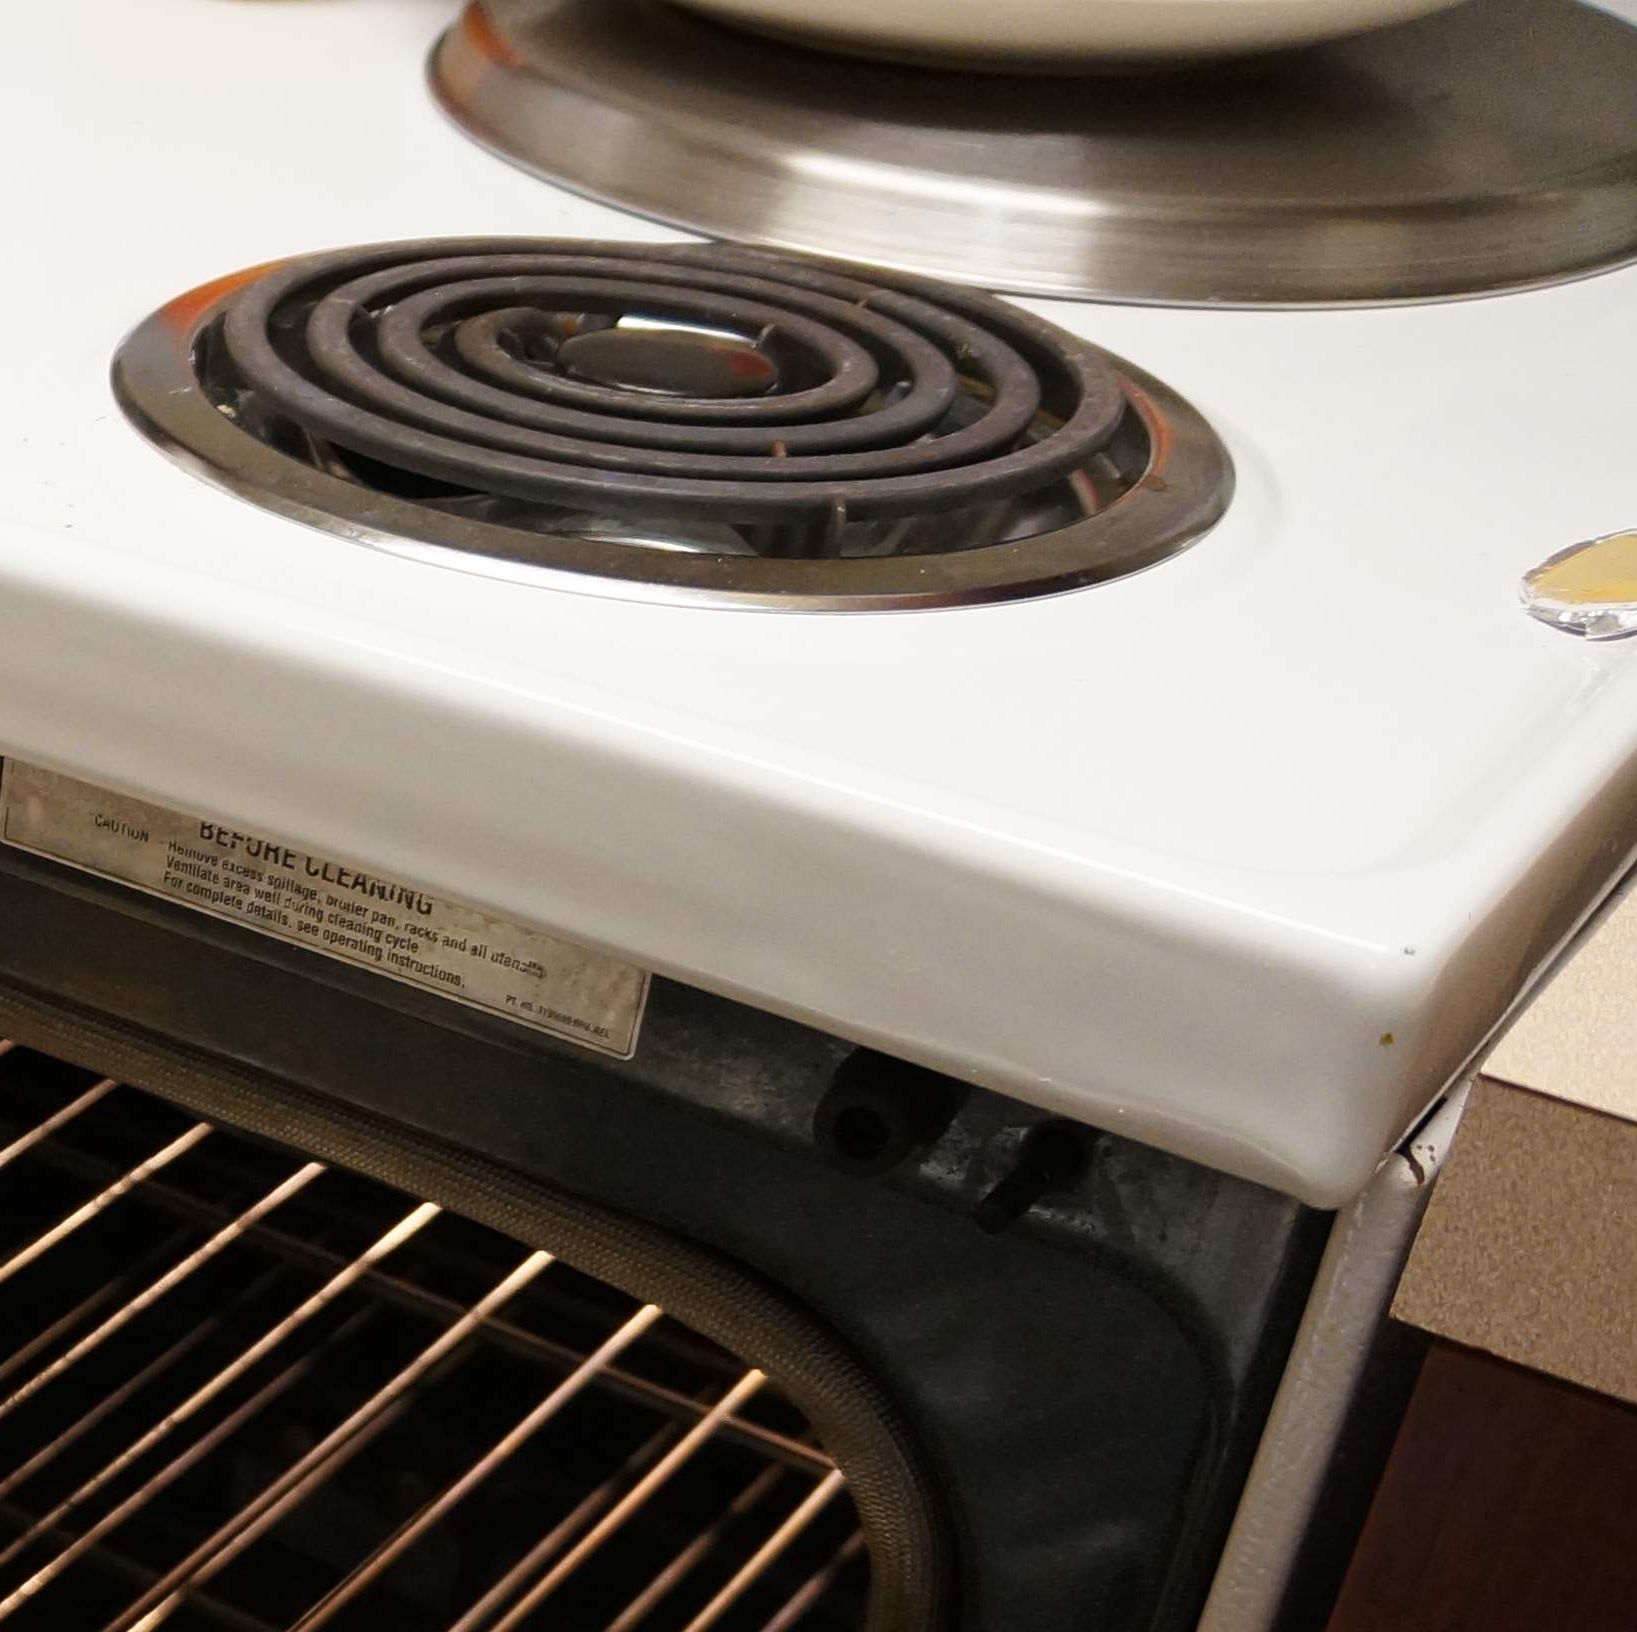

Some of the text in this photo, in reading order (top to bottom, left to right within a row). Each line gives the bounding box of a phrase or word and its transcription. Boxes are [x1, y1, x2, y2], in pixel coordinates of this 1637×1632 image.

[94, 813, 150, 843] CAUTION
[199, 821, 434, 916] BEFORE CLEANING
[163, 871, 183, 889] For
[186, 880, 243, 911] complete
[297, 920, 320, 937] see
[322, 929, 383, 963] operating
[386, 949, 466, 989] instructions.
[166, 855, 219, 885] Ventilate
[223, 874, 250, 897] area
[255, 886, 281, 907] well
[283, 895, 324, 924] during
[327, 912, 383, 943] cleaning
[222, 859, 264, 883] excess
[325, 893, 369, 918] broiler
[404, 922, 439, 944] racks
[442, 935, 468, 953] and
[471, 943, 488, 960] all
